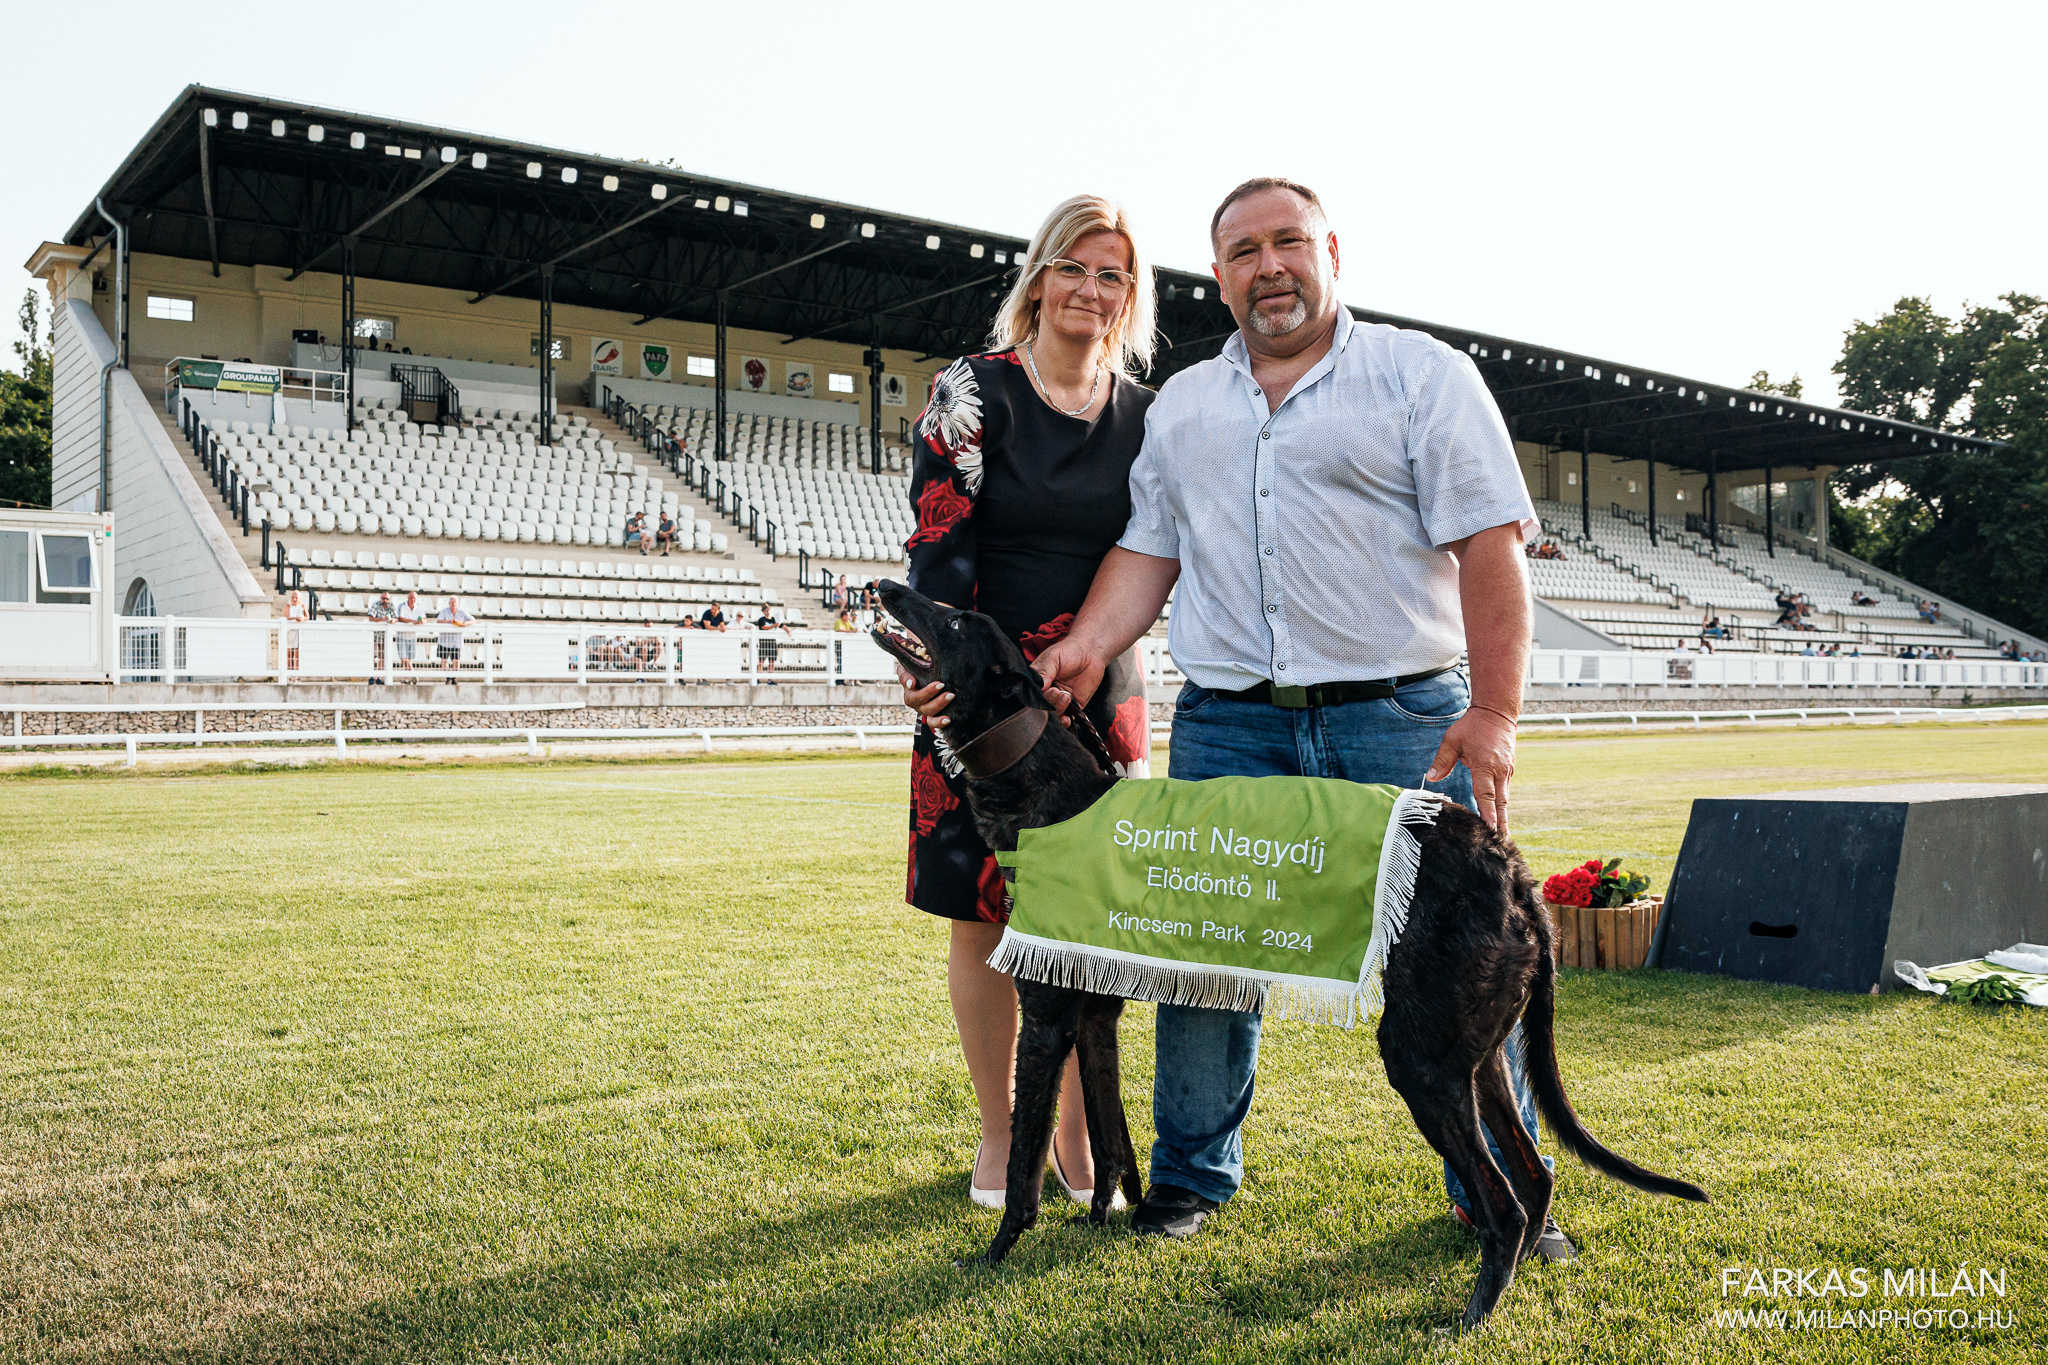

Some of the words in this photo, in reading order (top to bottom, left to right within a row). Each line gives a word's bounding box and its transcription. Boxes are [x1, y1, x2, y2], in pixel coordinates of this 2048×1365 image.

[645, 352, 667, 362] PAFC
[593, 363, 619, 373] BARC
[223, 372, 274, 383] GROUPAMA
[1113, 819, 1199, 853] Sprint
[1210, 826, 1325, 874] Nagydíj
[1108, 910, 1192, 938] Kincsem
[1201, 920, 1247, 943] Park
[1261, 928, 1314, 953] 2024
